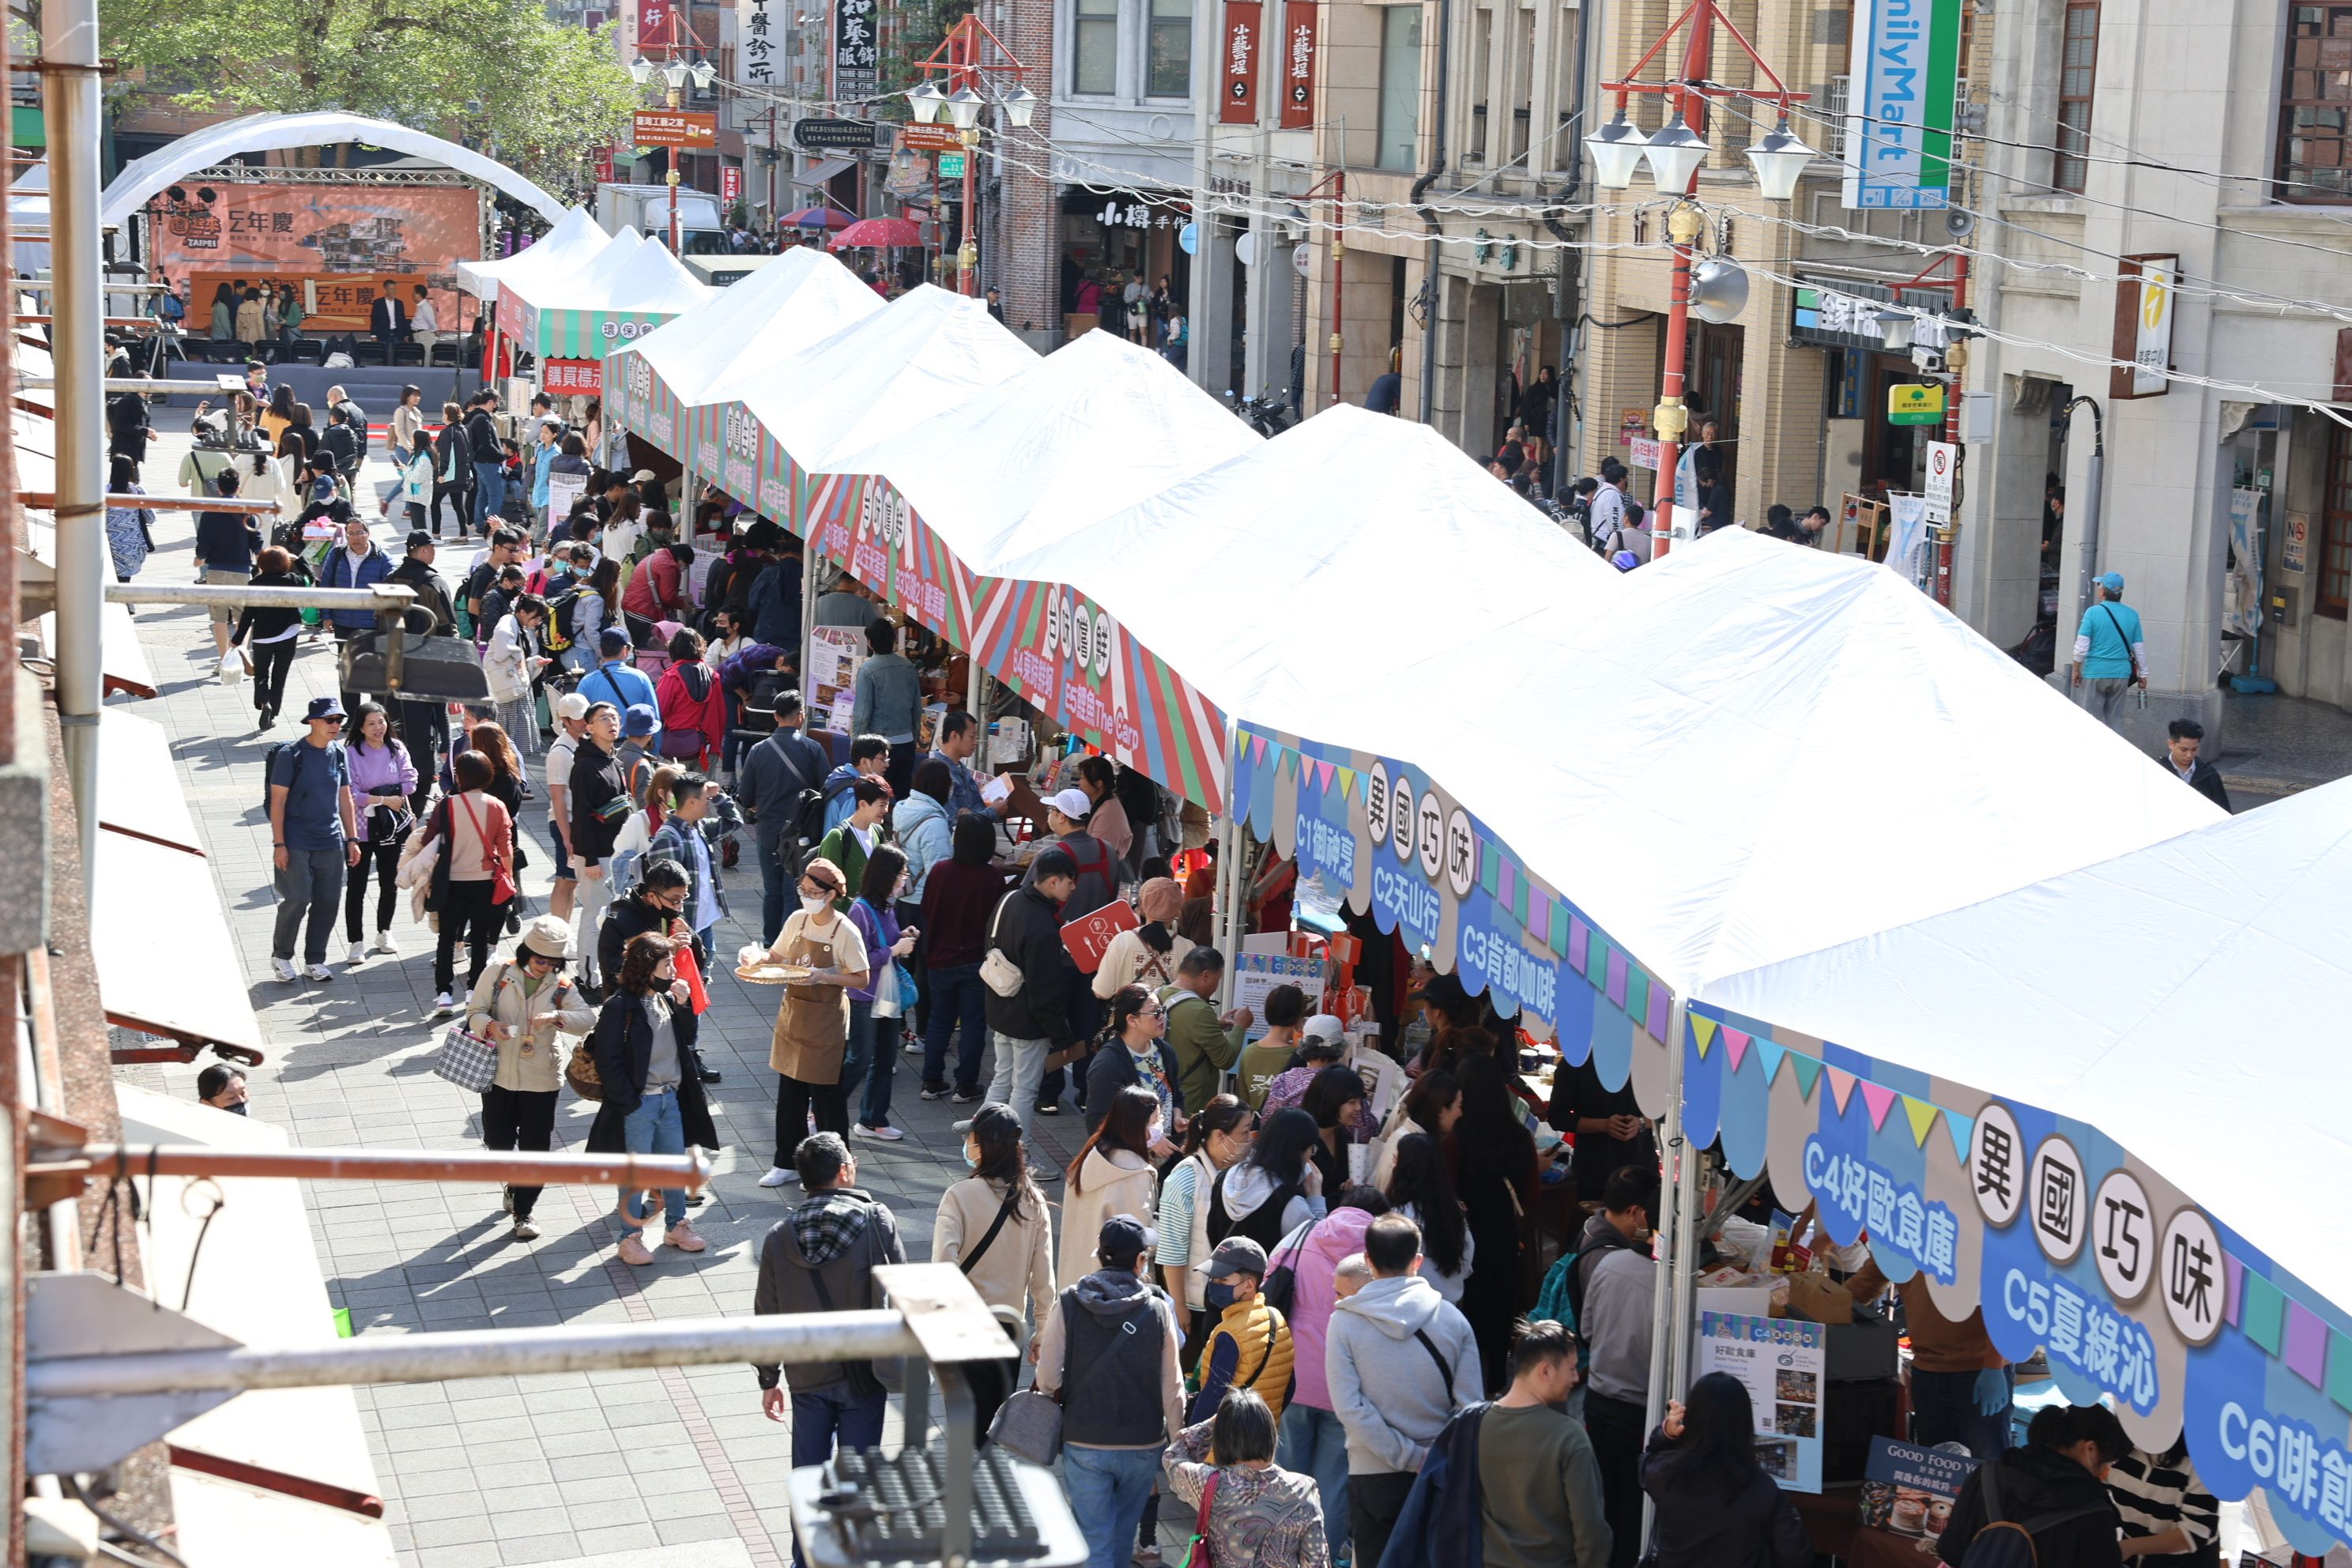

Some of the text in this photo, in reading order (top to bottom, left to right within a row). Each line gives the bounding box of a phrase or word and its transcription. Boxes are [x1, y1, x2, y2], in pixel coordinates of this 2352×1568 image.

[187, 239, 217, 247] TAIPEI
[1115, 710, 1139, 751] Carp
[1297, 813, 1355, 890] C1御神烹
[1370, 772, 1469, 884] 異國巧味
[1374, 865, 1440, 940] C2天山行
[1463, 924, 1556, 1022] C3肯都咖啡
[1805, 1140, 1955, 1279] C4好歐食庫
[1978, 1120, 2213, 1325] 異國巧味
[1755, 1328, 1771, 1337] C4
[2003, 1267, 2155, 1408] C5夏綠沁
[1887, 1445, 1924, 1463] GOOD
[1928, 1454, 1962, 1472] FOOD
